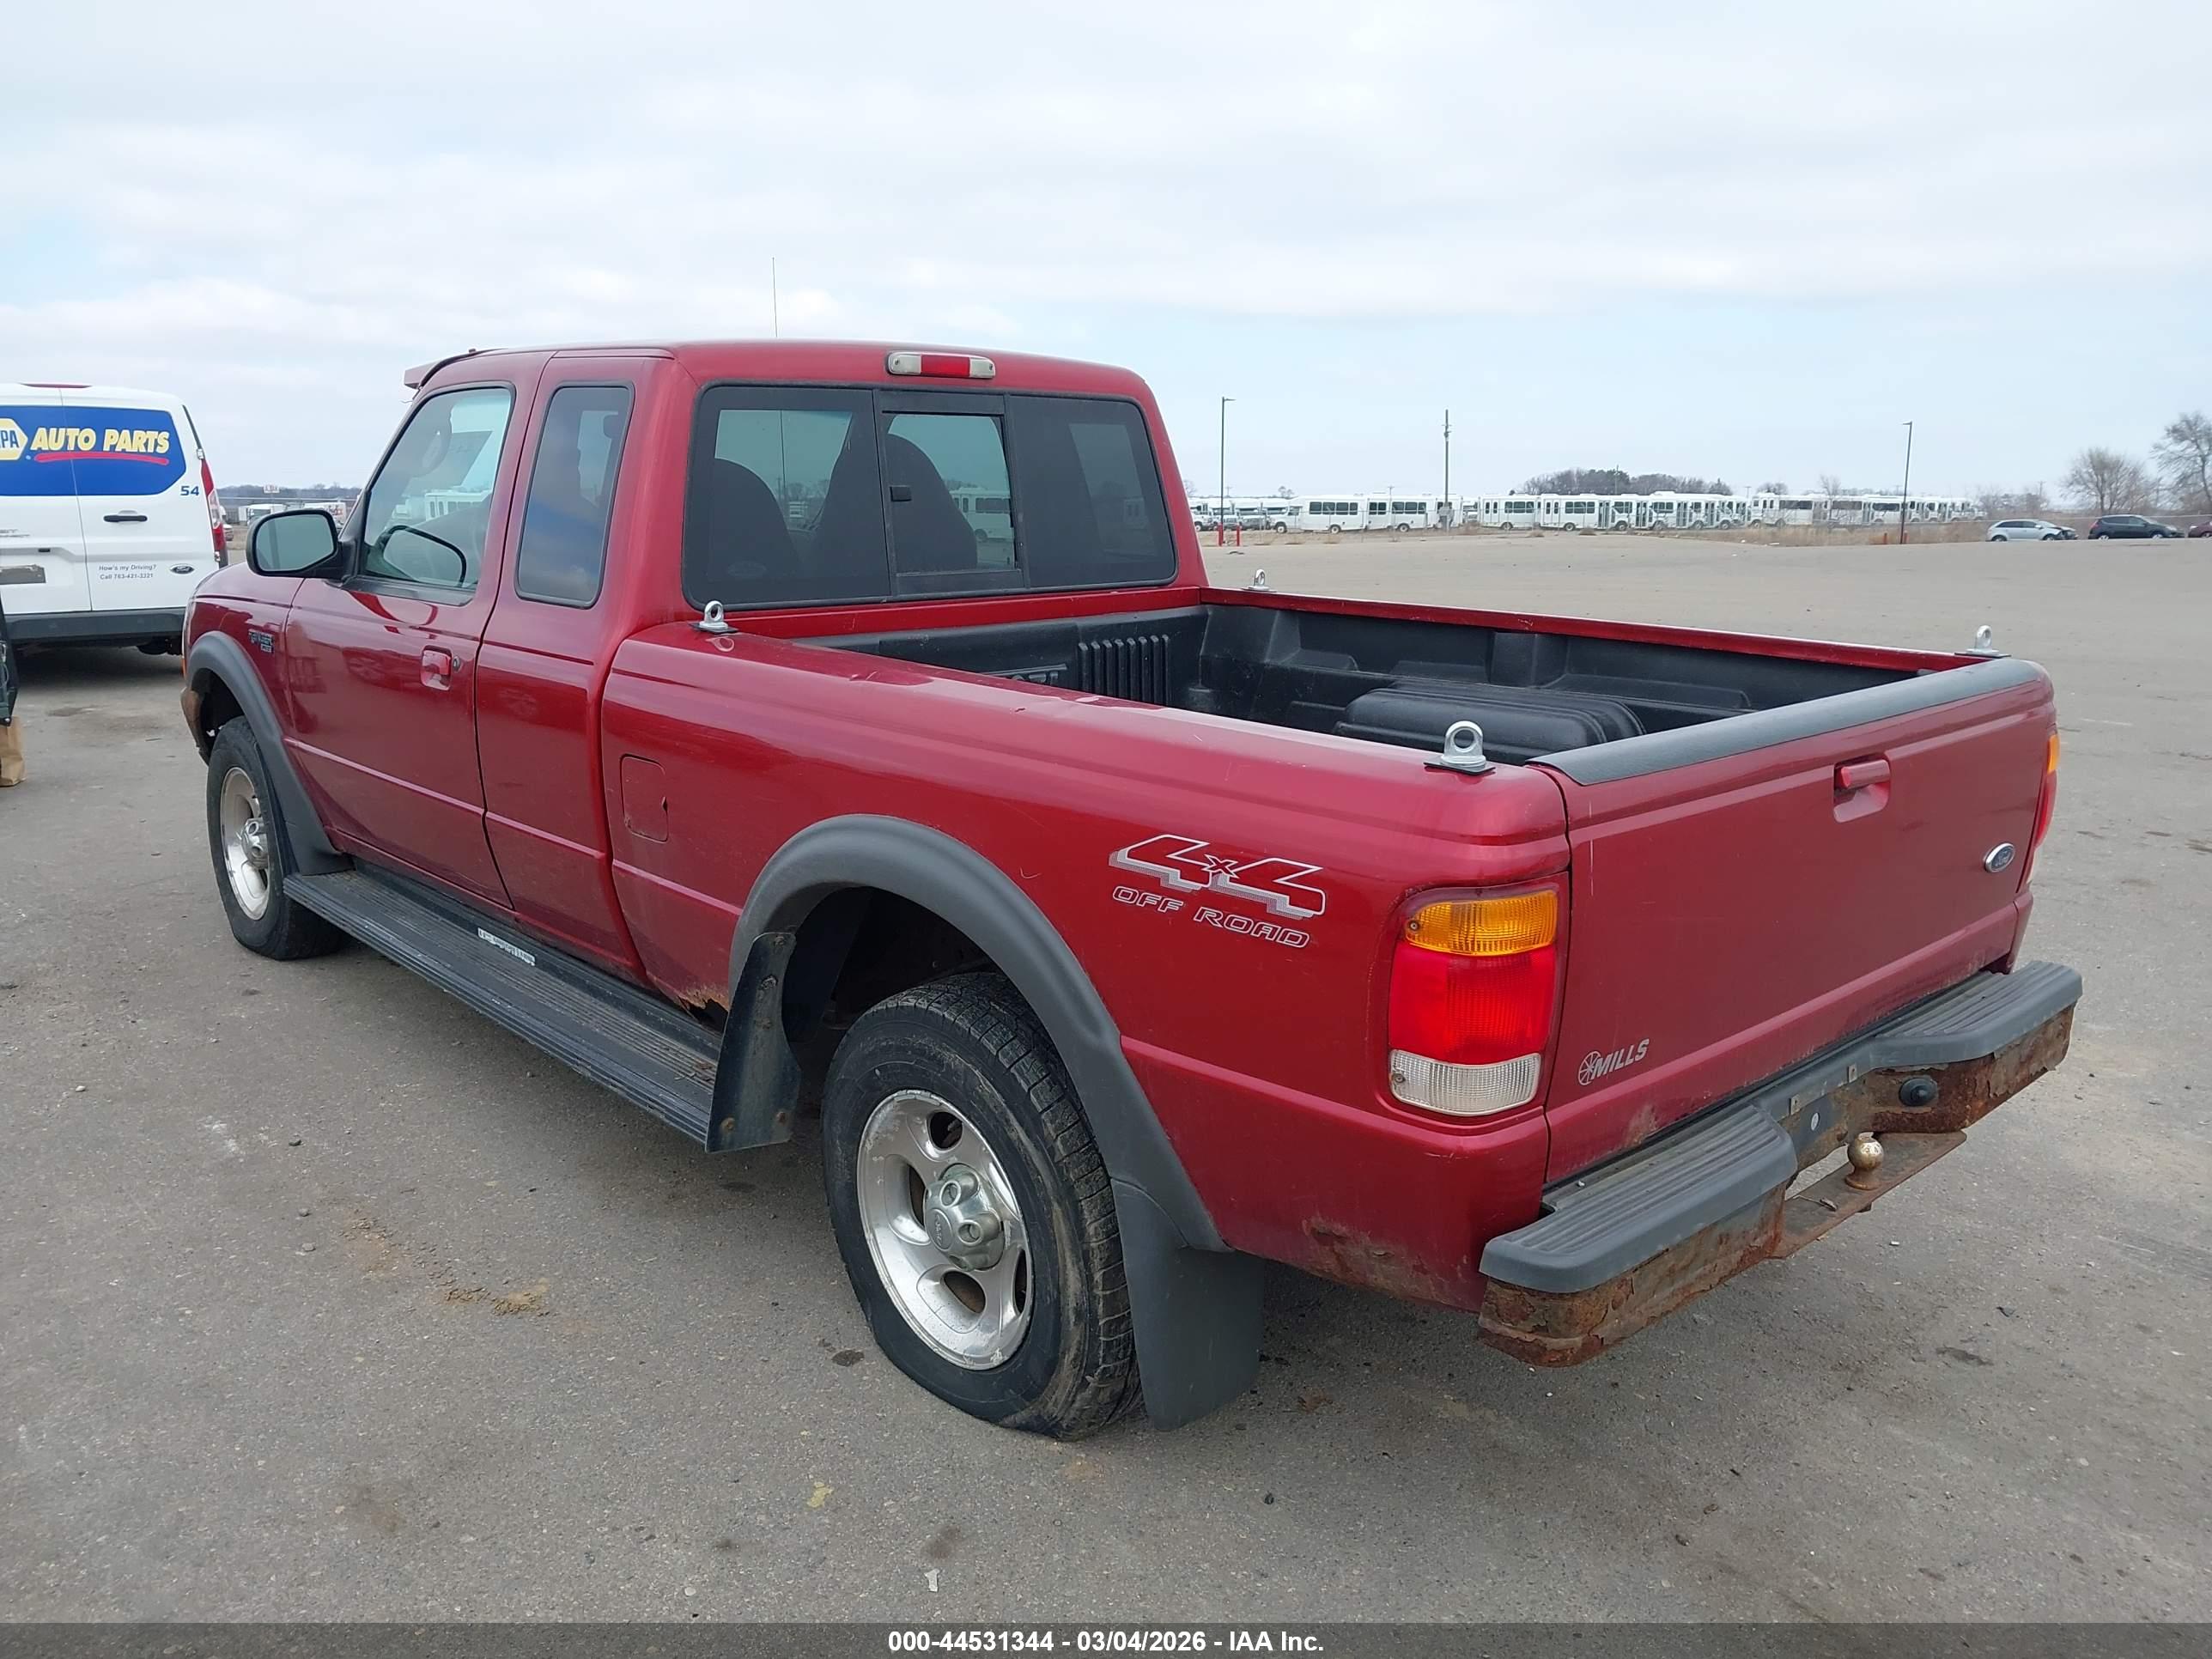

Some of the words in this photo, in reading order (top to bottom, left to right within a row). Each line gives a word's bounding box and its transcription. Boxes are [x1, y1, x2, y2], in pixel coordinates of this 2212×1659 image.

[0, 430, 20, 448] PA
[30, 427, 96, 451] AUTO
[103, 428, 170, 453] PARTS
[179, 485, 200, 496] 54
[1112, 885, 1184, 913] OFF
[1193, 906, 1310, 949] ROAD
[1590, 1038, 1650, 1080] MILLS
